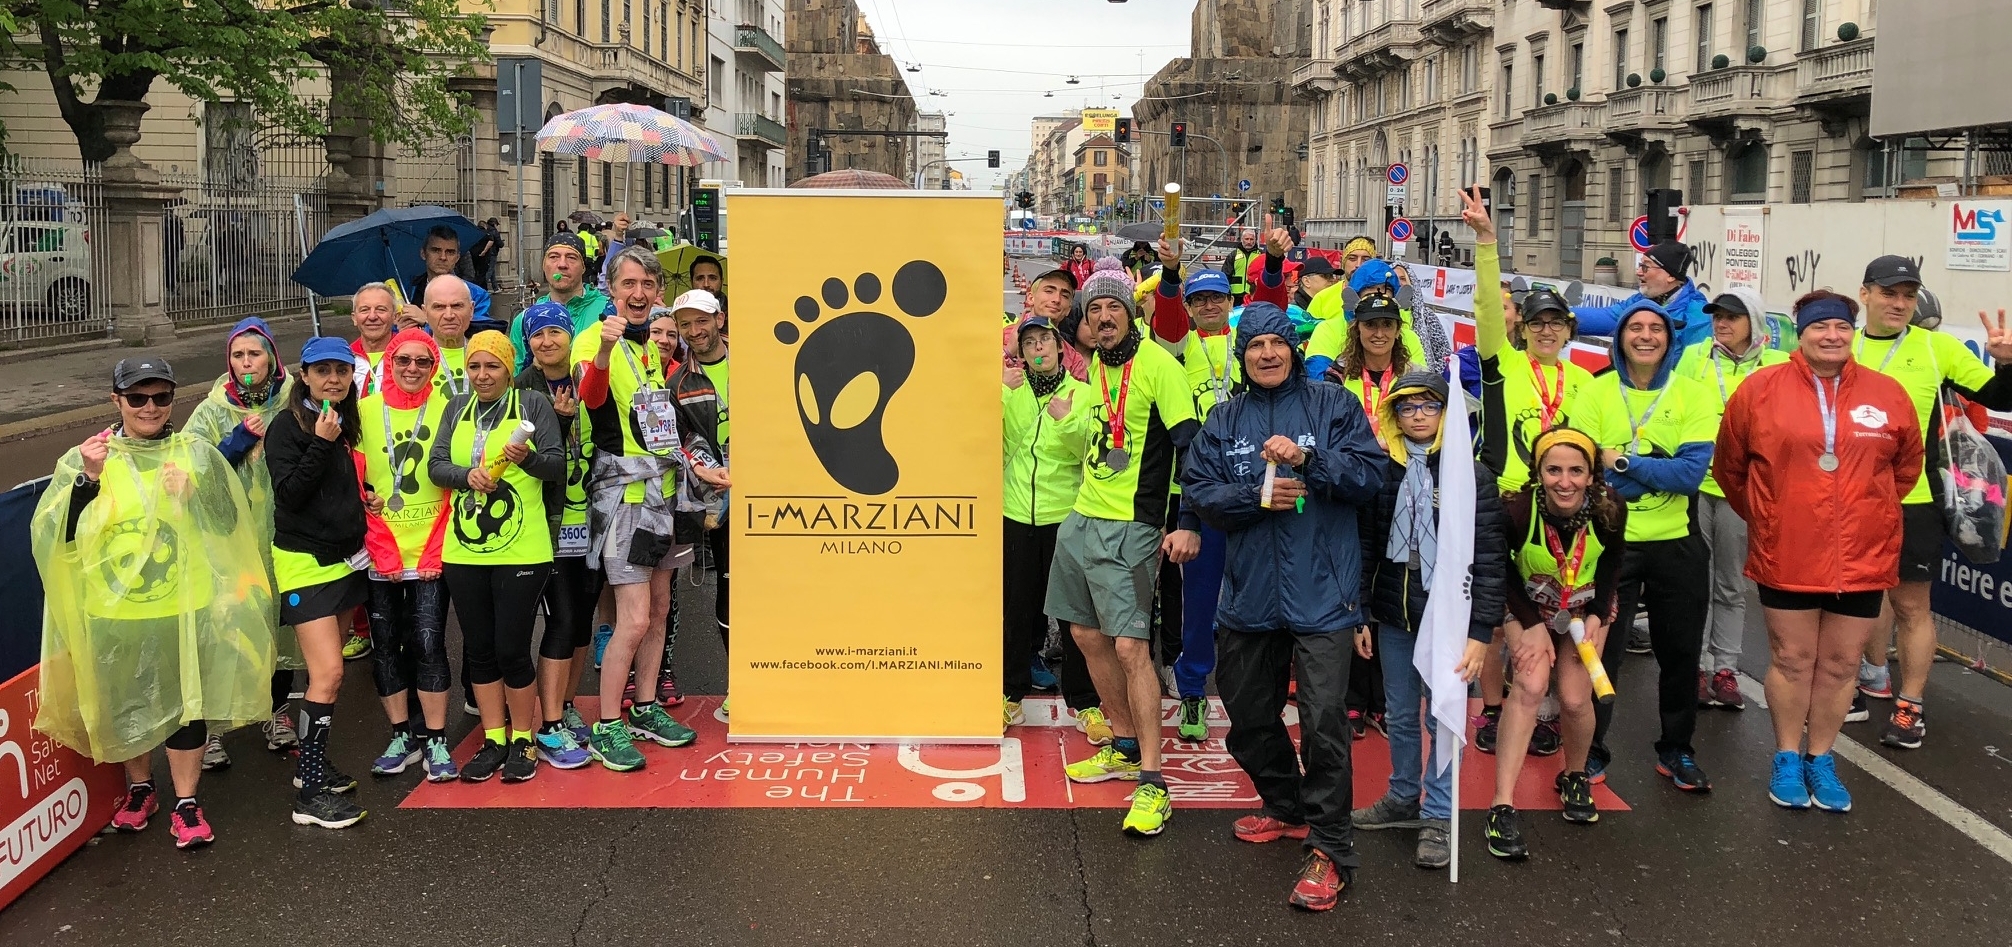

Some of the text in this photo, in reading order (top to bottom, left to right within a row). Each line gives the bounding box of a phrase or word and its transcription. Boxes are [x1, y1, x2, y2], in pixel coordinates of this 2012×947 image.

[1726, 229, 1760, 243] Di Falco
[1690, 240, 1716, 282] BUY
[1725, 248, 1760, 258] NOLEGGIO
[1725, 258, 1759, 268] PONTEGGI
[1786, 249, 1821, 293] BUY
[382, 503, 444, 521] MARZIANI
[747, 503, 974, 530] I-MARZIANI
[395, 521, 425, 529] MILANO
[820, 541, 902, 554] MILANO
[1941, 552, 1994, 600] riere
[665, 580, 680, 664] adidas neo
[815, 645, 918, 657] www.i-marziani.it
[750, 659, 983, 671] www.facebook.com/I.MARZIANI.Milano
[704, 750, 871, 767] Safety
[34, 758, 61, 791] Net
[680, 768, 866, 784] Human
[765, 785, 865, 802] The
